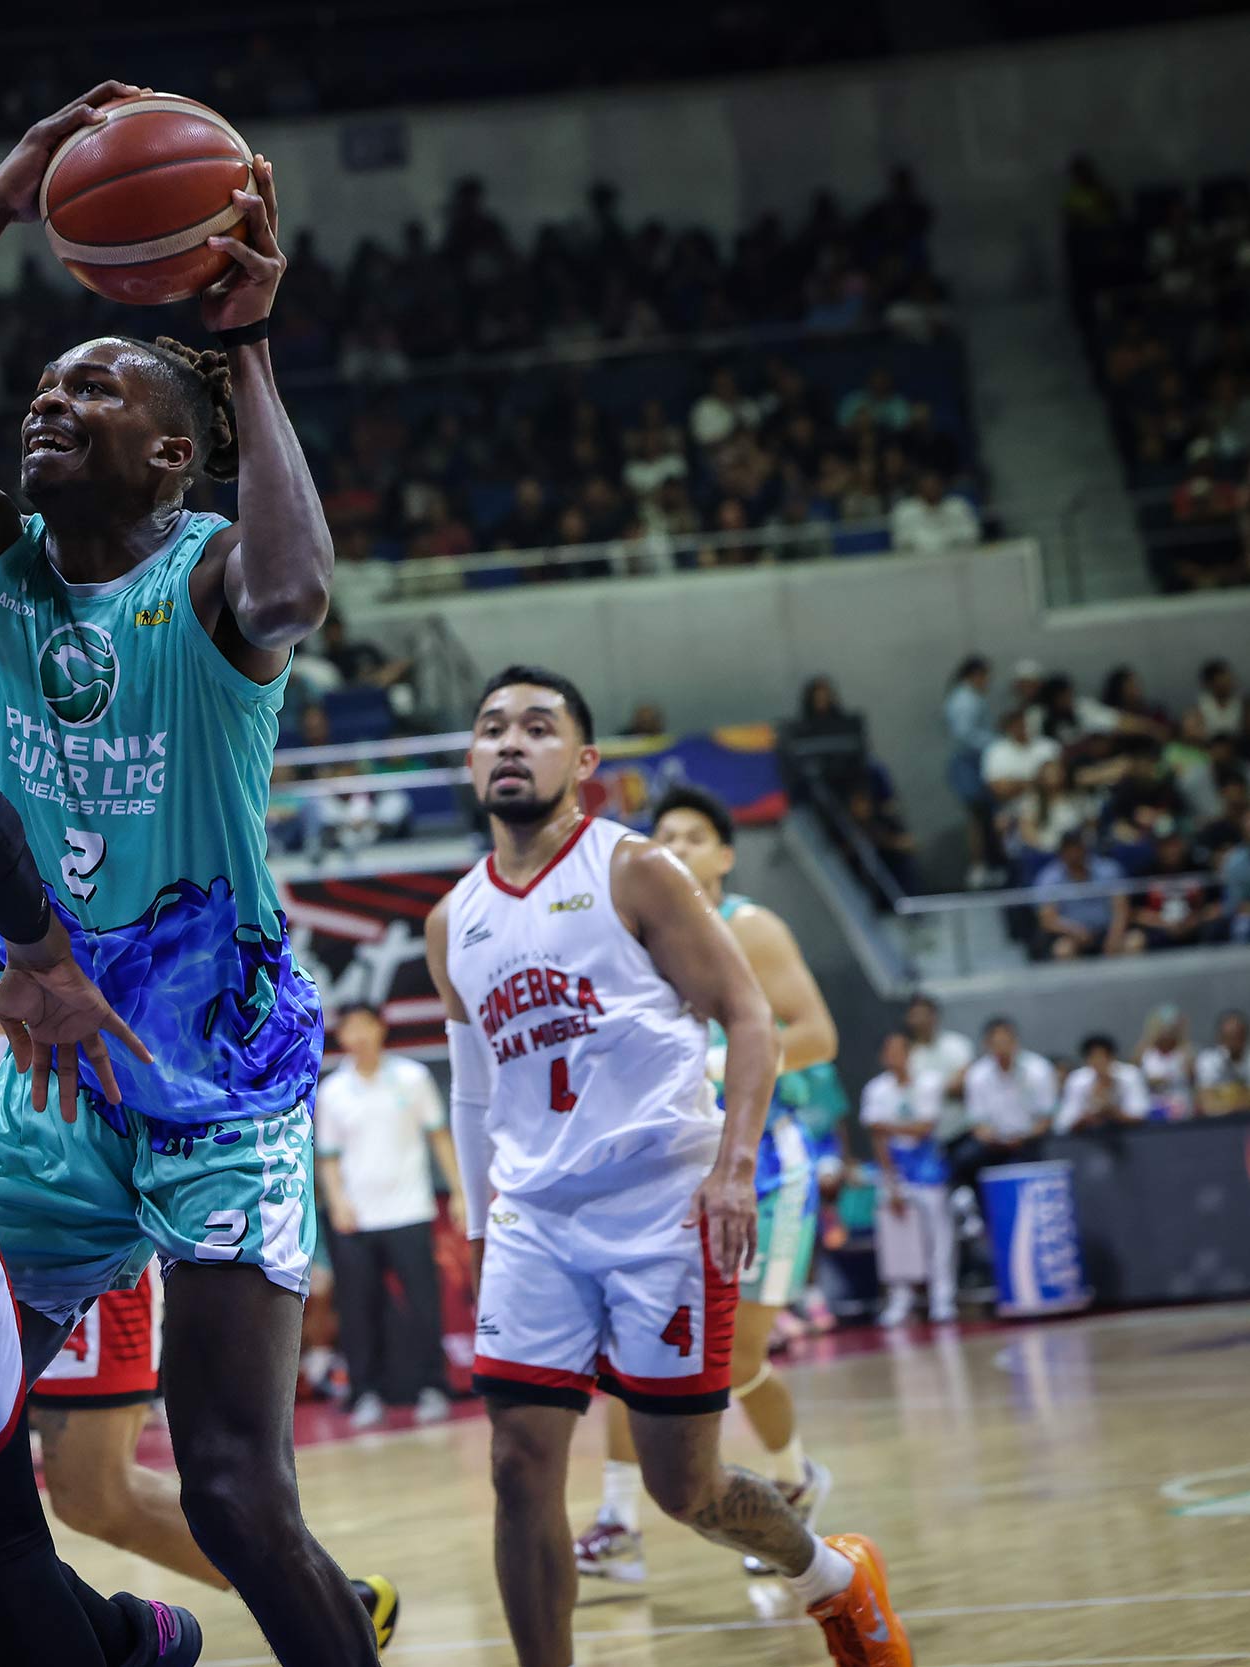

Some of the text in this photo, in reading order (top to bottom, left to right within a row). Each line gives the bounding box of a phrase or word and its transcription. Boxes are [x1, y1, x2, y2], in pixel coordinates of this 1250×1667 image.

[6, 705, 167, 762] PHOENIX
[102, 761, 166, 796] LPG
[60, 826, 106, 904] 2
[194, 1209, 249, 1262] 2
[660, 1304, 694, 1358] 4
